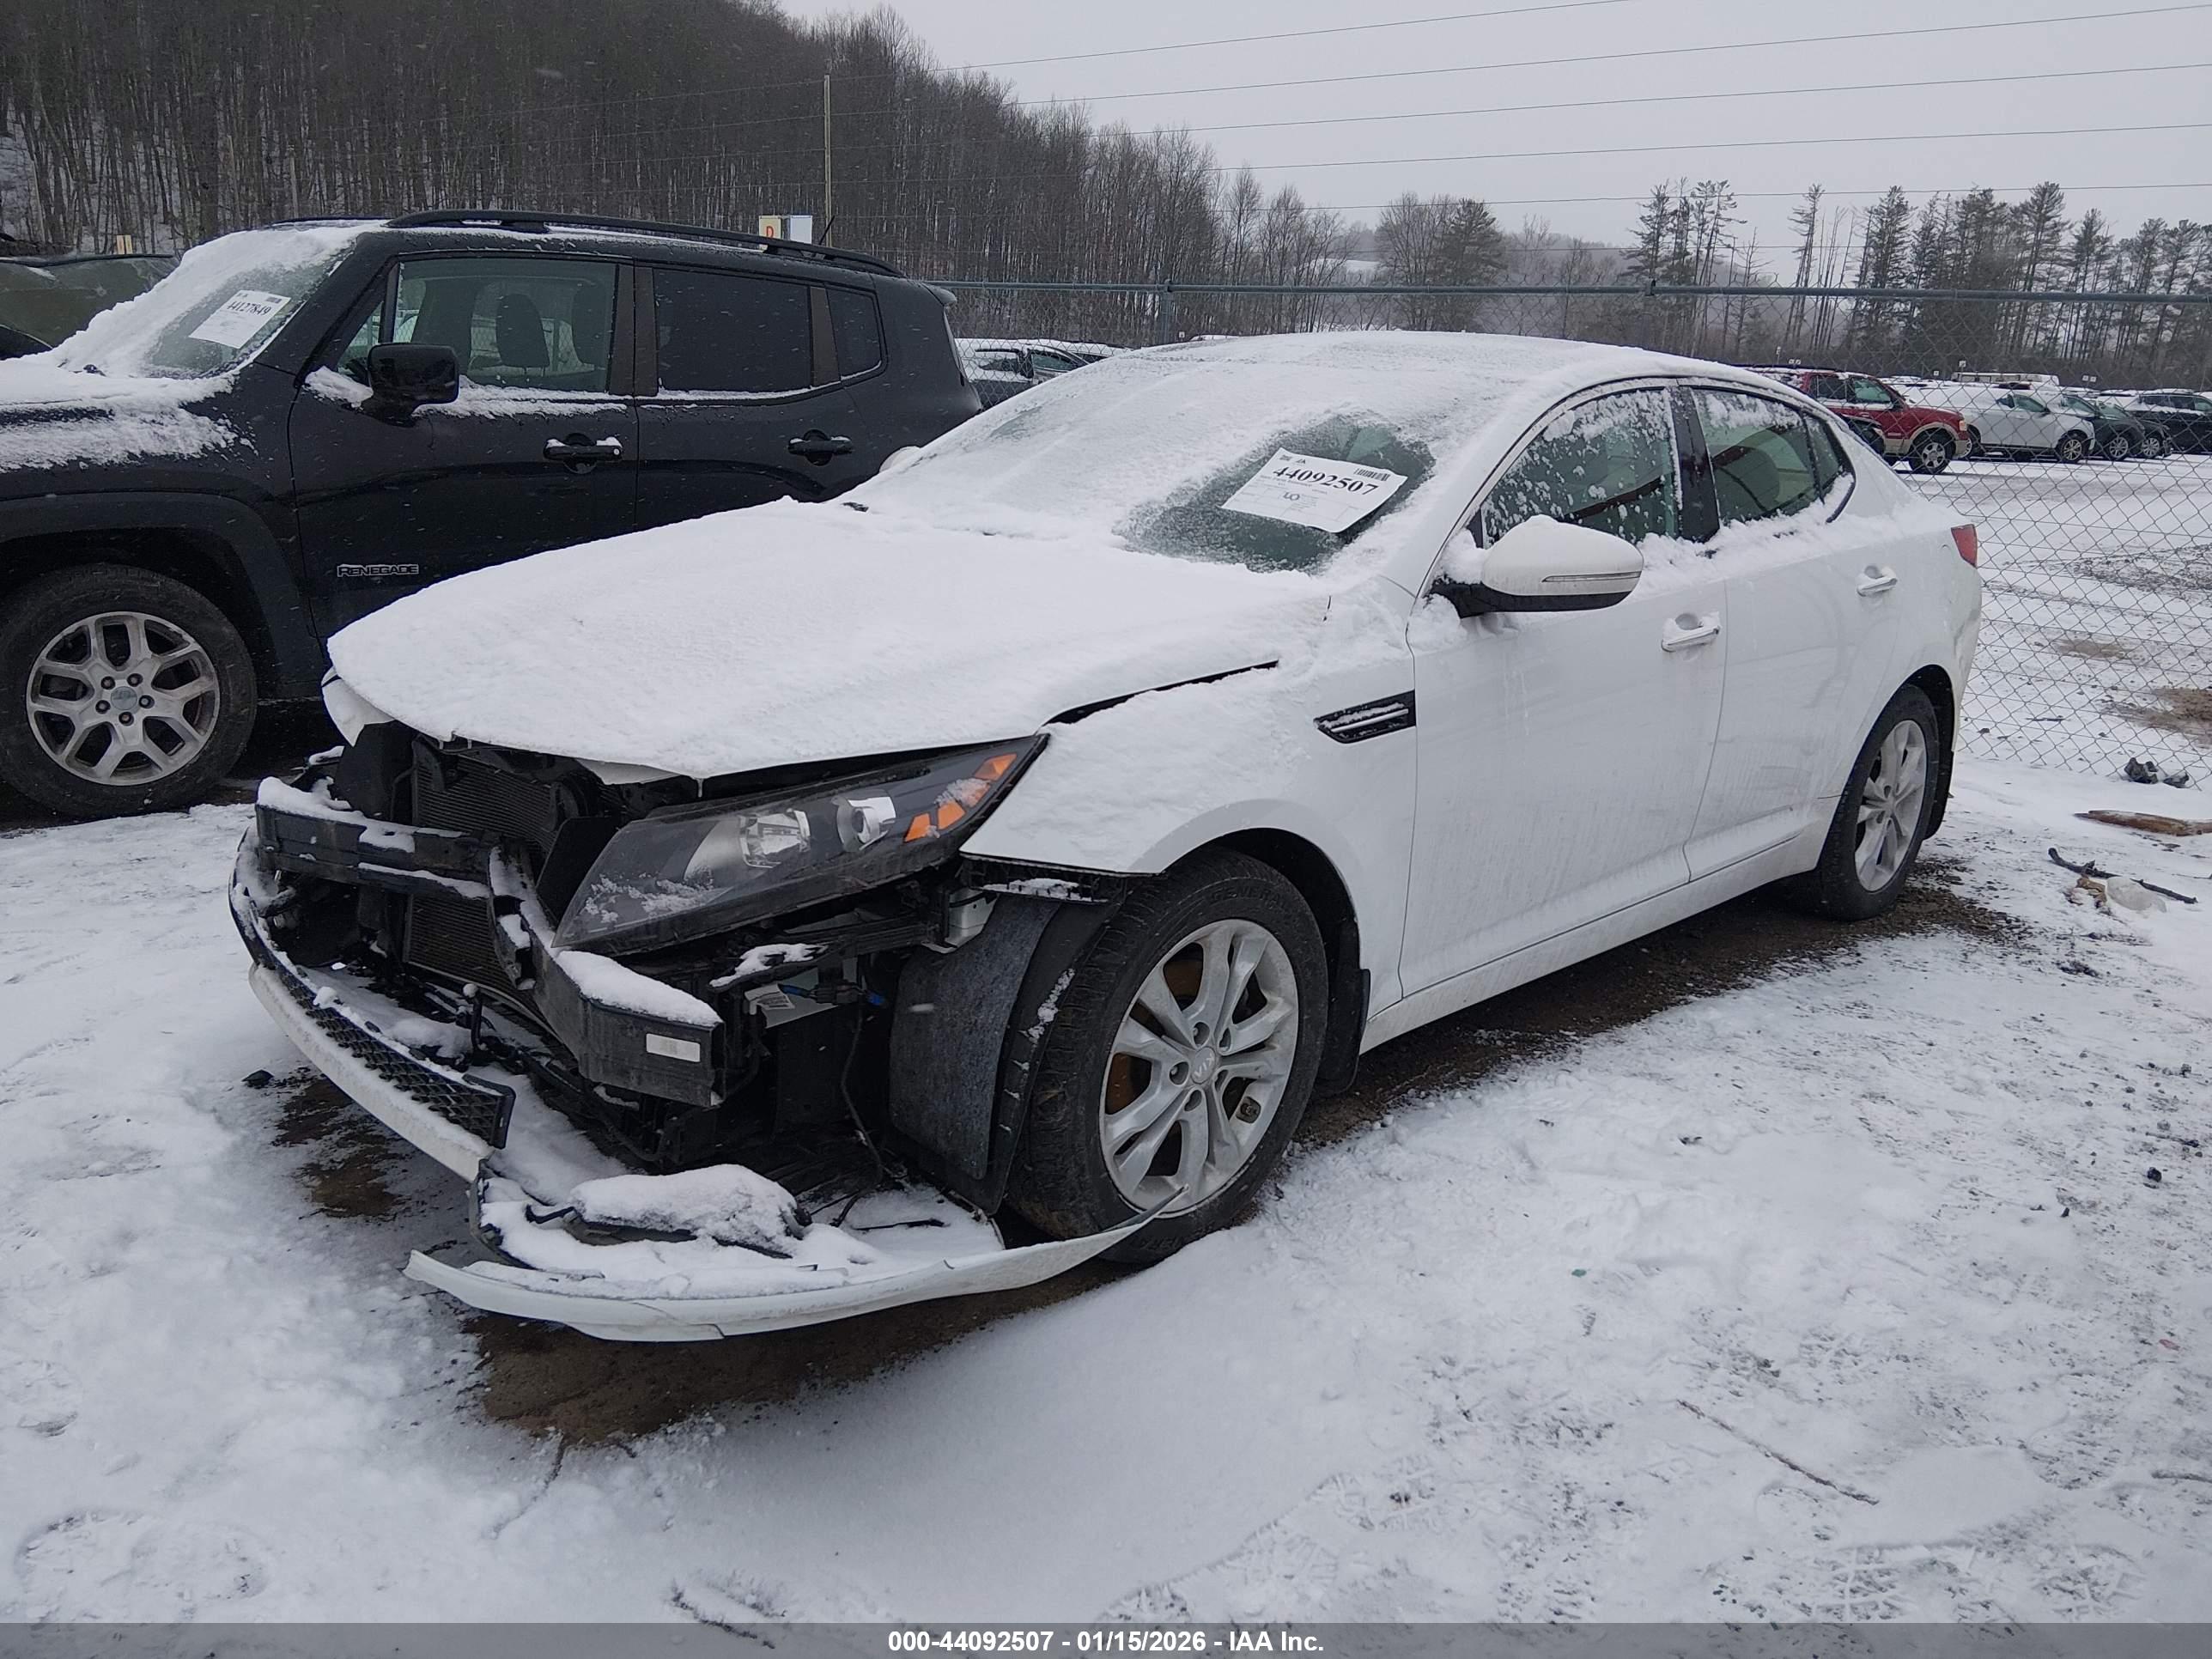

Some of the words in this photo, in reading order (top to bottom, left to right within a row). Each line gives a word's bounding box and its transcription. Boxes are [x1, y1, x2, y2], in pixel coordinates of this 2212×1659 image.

[227, 301, 272, 316] 44127849
[1273, 466, 1379, 495] 44092507
[337, 564, 419, 577] RENEGADE
[1194, 1052, 1215, 1077] KIA
